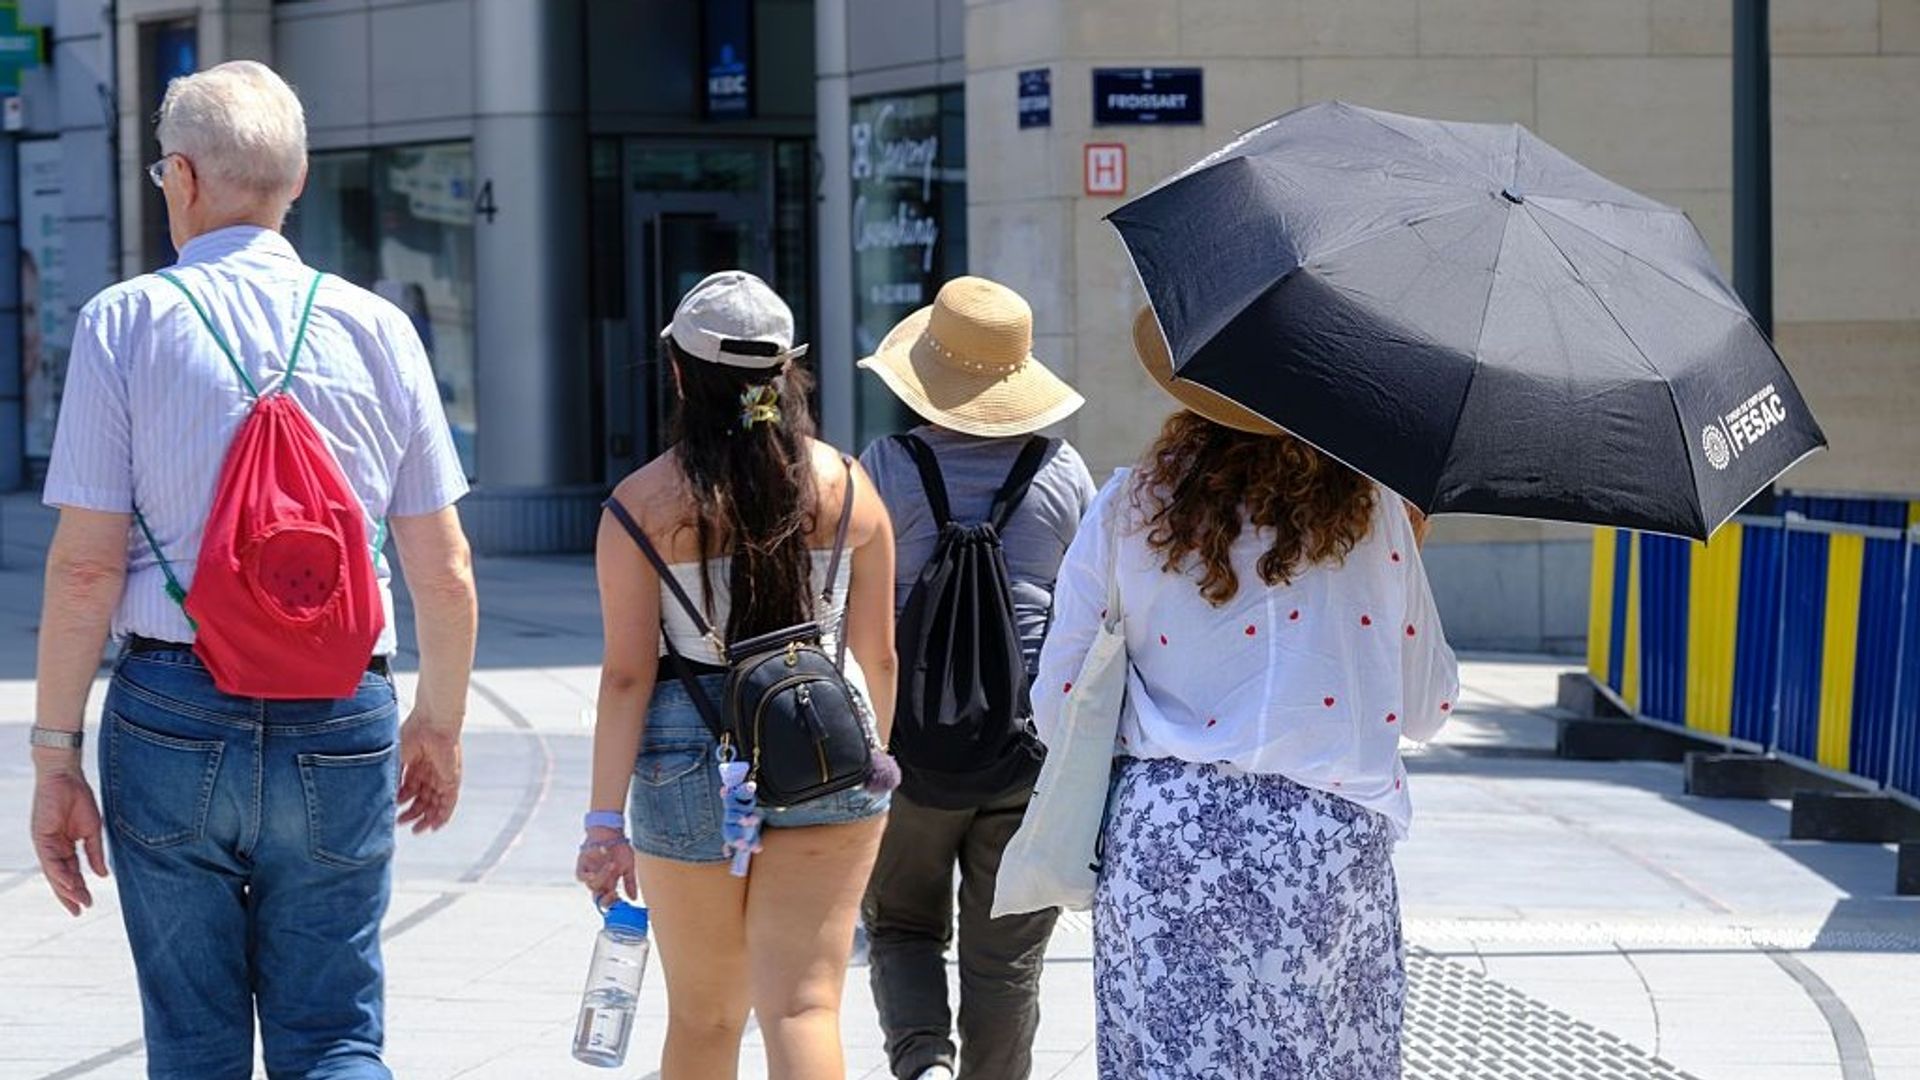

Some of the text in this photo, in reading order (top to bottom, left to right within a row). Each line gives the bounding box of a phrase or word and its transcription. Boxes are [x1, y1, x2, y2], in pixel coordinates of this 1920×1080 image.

[708, 76, 747, 95] KBC
[1107, 93, 1188, 110] FROISSART
[1095, 153, 1116, 184] H
[475, 178, 498, 223] 4
[1729, 393, 1786, 452] FESAC
